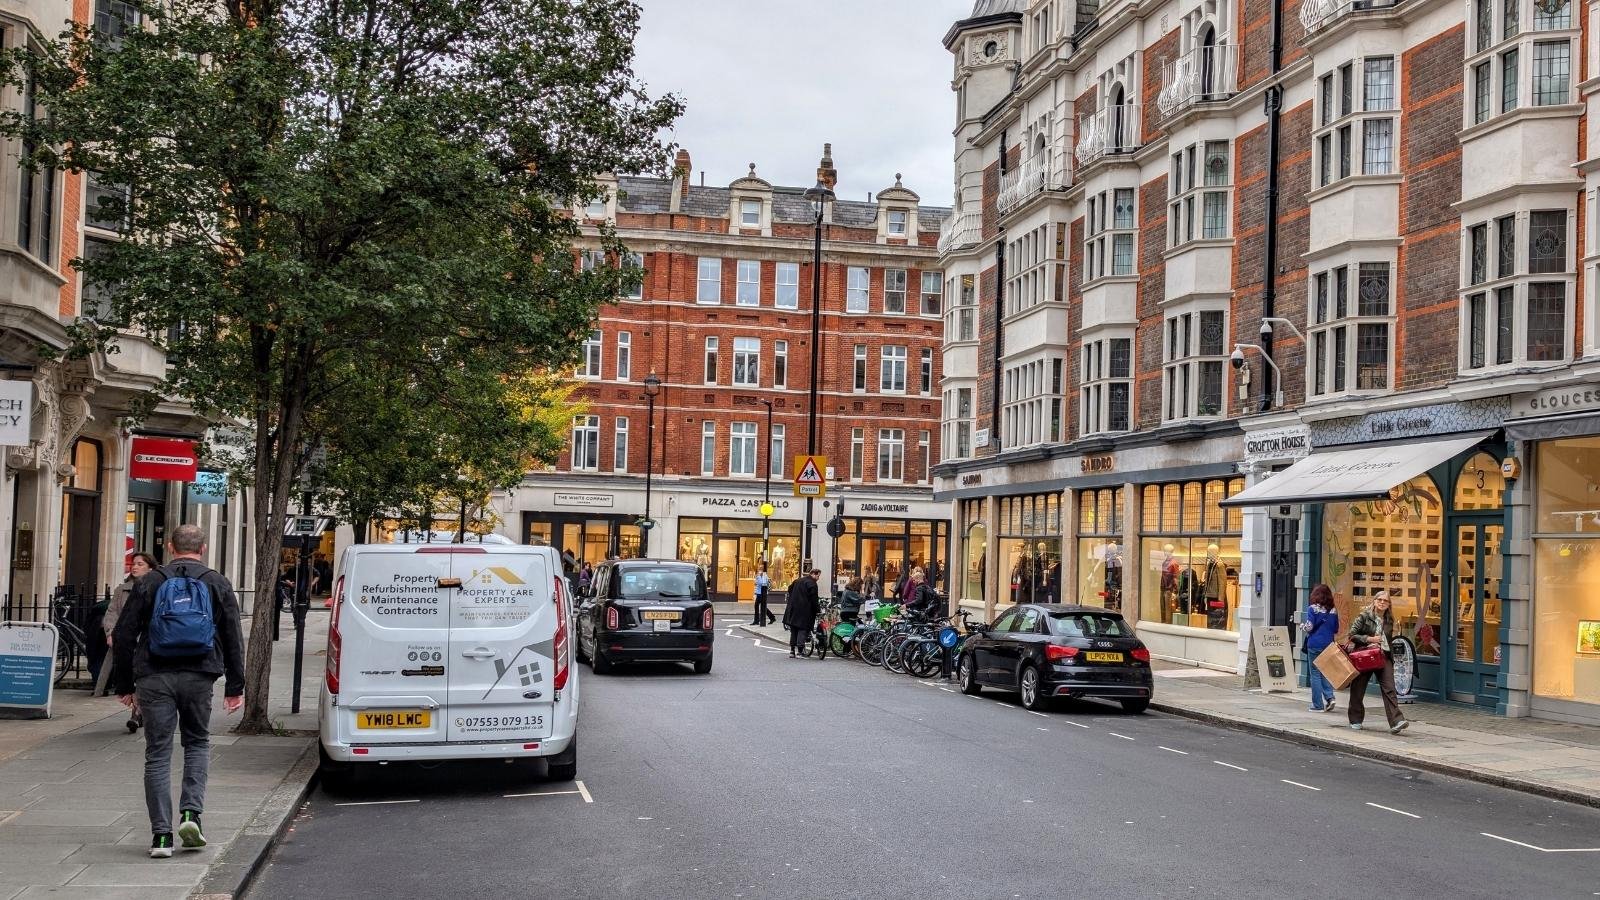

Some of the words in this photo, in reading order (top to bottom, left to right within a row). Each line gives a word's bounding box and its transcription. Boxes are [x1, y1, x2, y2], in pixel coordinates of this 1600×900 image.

[1371, 419, 1394, 433] Little
[1397, 417, 1432, 431] Greene
[1281, 436, 1306, 450] HOUSE
[1080, 455, 1114, 473] SANDRO
[962, 473, 982, 486] SANDRO
[1476, 469, 1485, 490] 3
[702, 497, 736, 506] PIAZZA
[740, 499, 789, 508] CASTLLO
[393, 574, 438, 585] Property
[362, 584, 438, 594] Refurbishment
[456, 589, 506, 597] PROPERTY
[360, 595, 368, 604] &
[371, 594, 438, 604] Maintenance
[377, 606, 438, 615] Contractors
[365, 714, 394, 726] YW18
[397, 713, 422, 725] LWC
[466, 717, 499, 727] 07553
[502, 716, 522, 726] 079
[525, 715, 543, 725] 135
